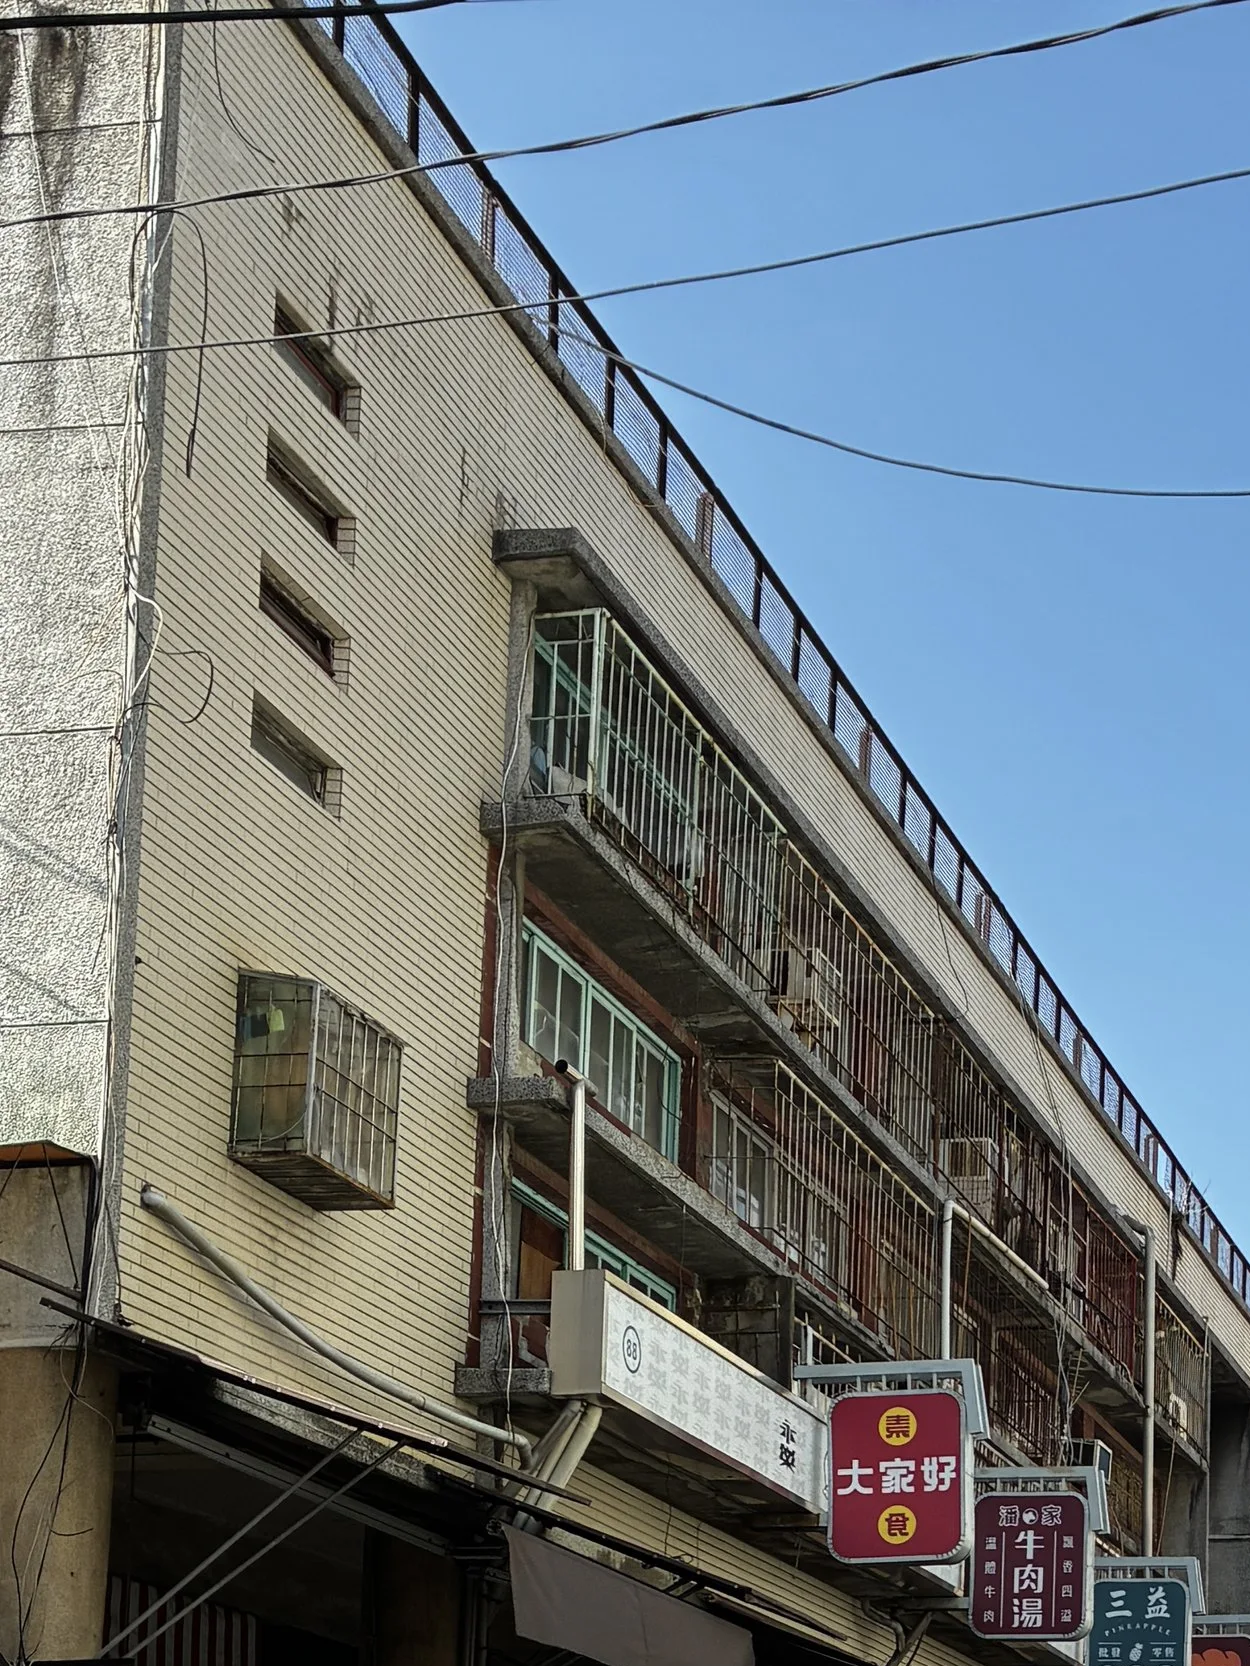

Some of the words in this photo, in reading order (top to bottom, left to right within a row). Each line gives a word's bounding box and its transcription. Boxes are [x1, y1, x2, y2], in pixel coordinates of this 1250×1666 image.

[626, 1338, 638, 1361] 88
[884, 1413, 912, 1440] 素
[837, 1455, 957, 1497] 大家好
[884, 1512, 911, 1538] 食
[999, 1505, 1062, 1527] 潘家
[1011, 1529, 1045, 1629] 牛肉湯
[1105, 1586, 1171, 1619] 三益
[1104, 1623, 1171, 1637] PINEAPPLE
